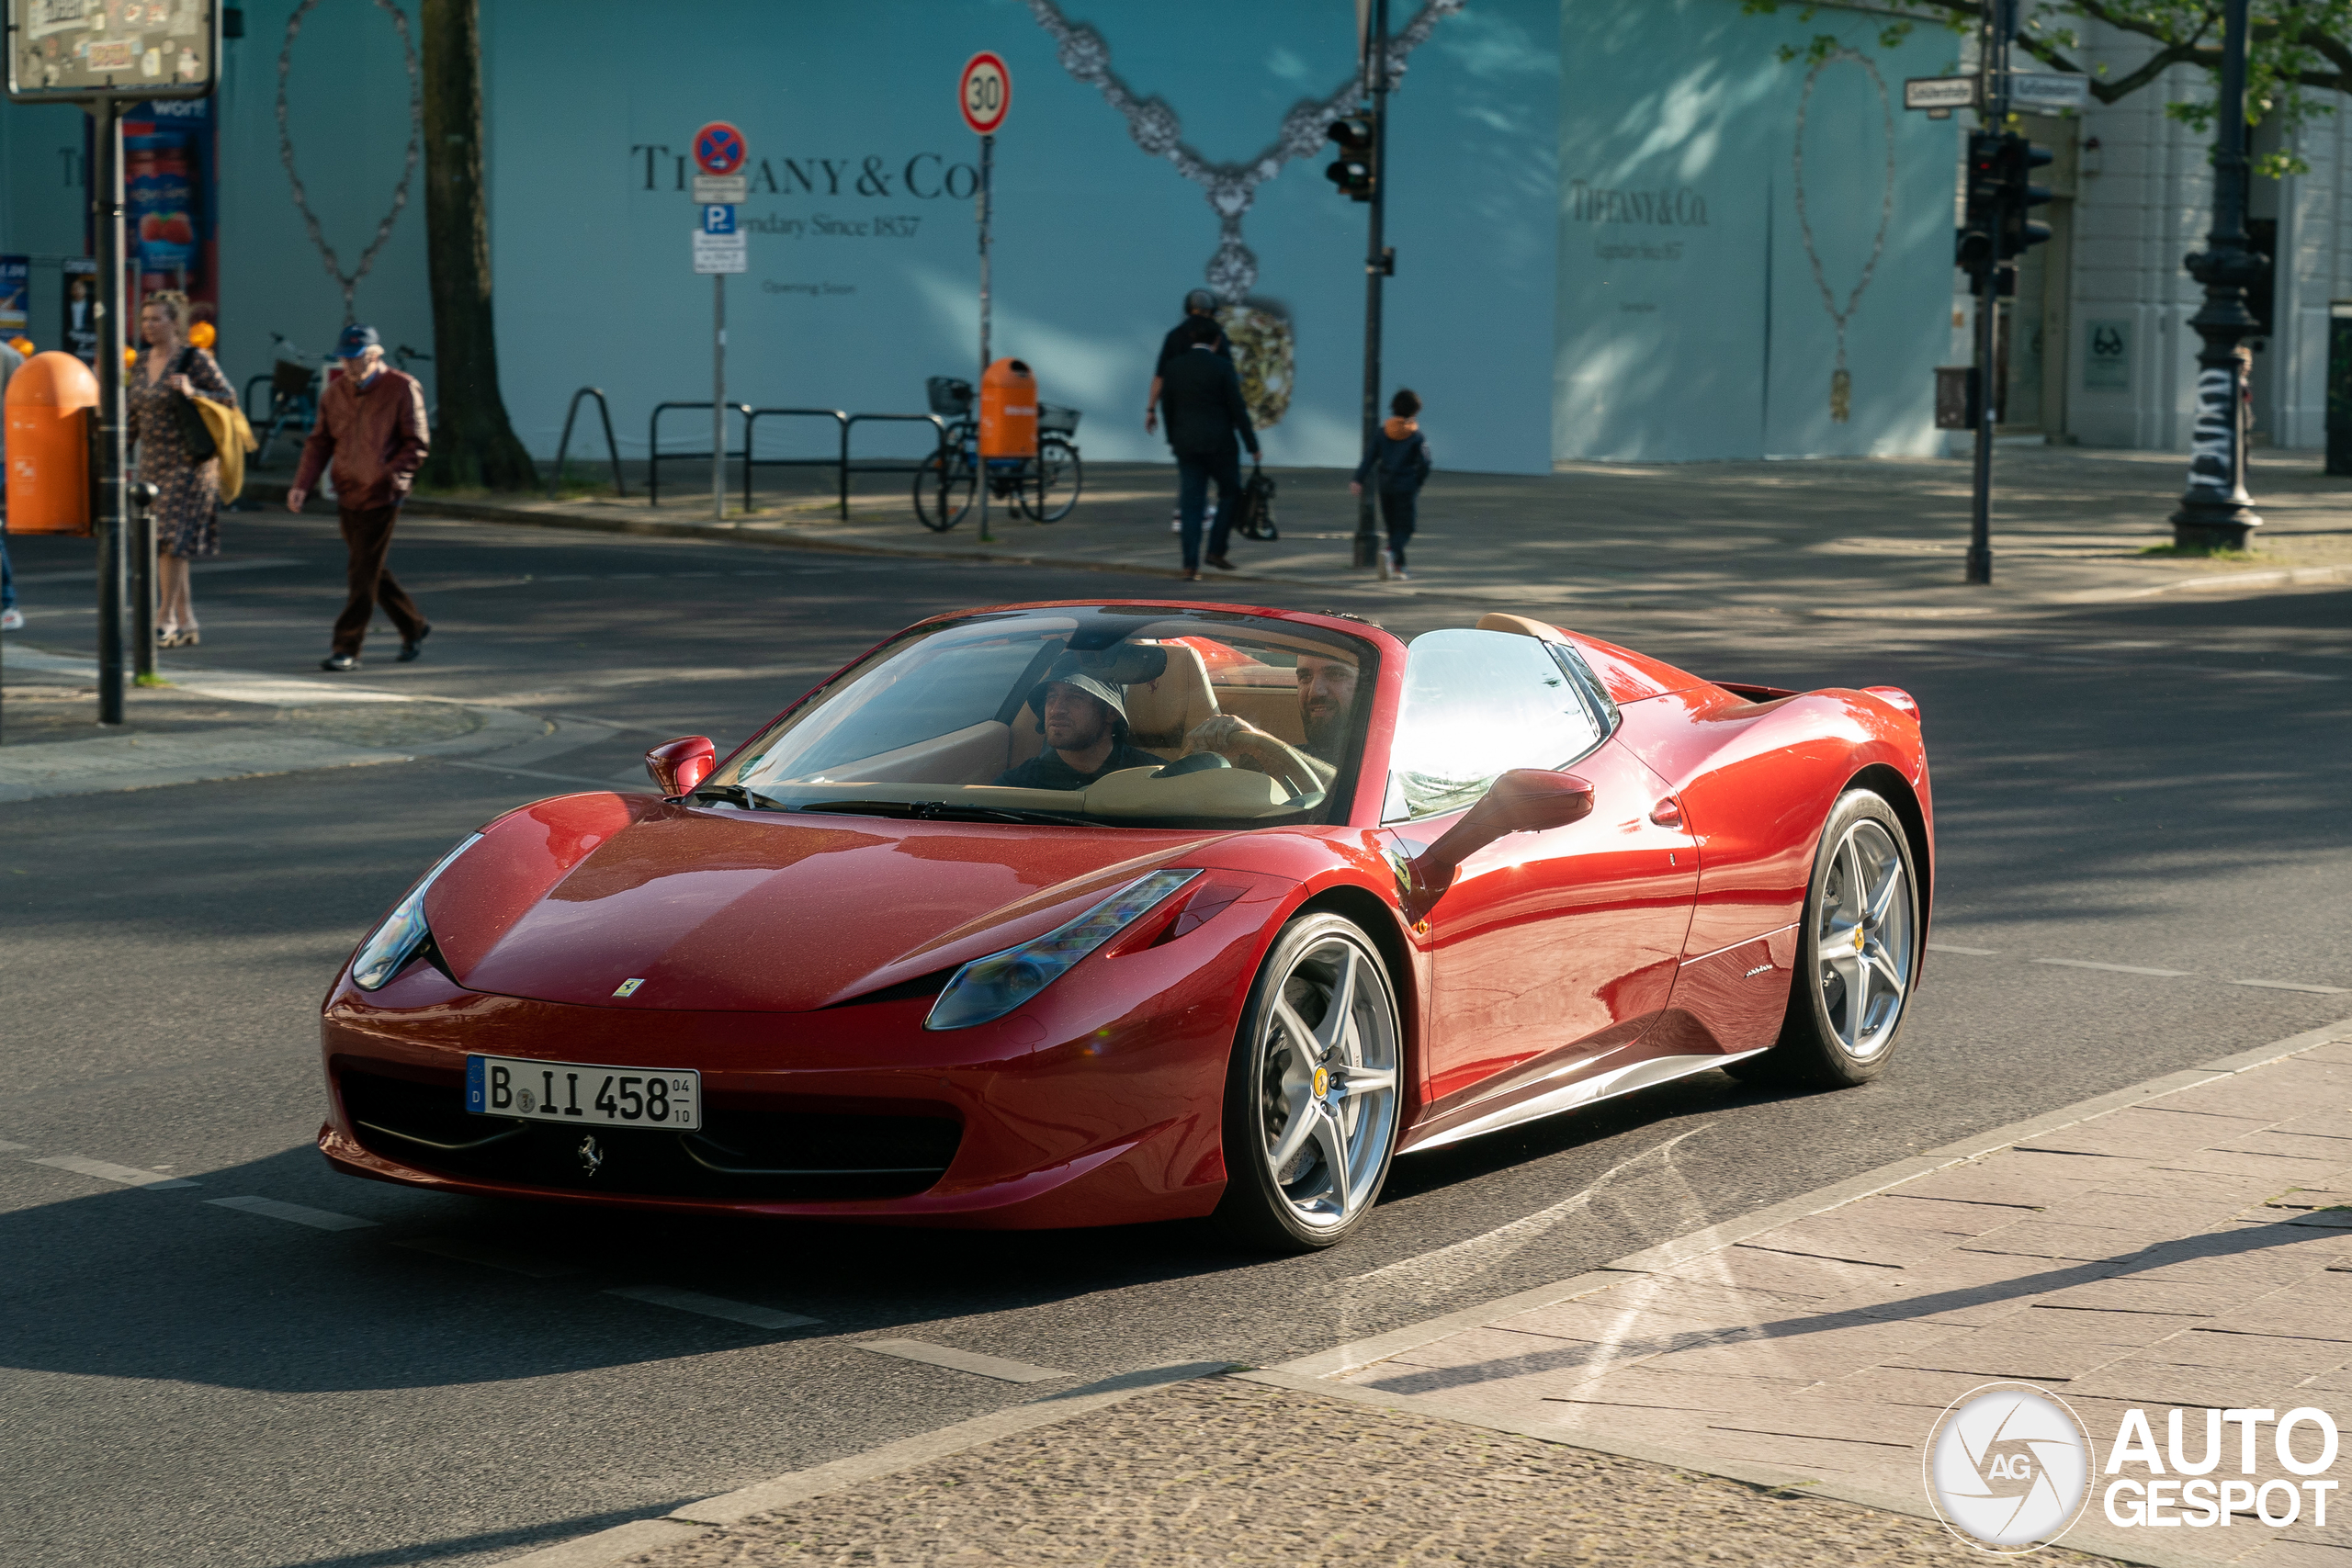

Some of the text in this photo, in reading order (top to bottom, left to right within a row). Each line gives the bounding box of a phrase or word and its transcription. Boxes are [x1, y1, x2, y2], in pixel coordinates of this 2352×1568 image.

[968, 75, 1000, 111] 30
[630, 143, 851, 197] TIANY
[707, 205, 728, 231] P
[472, 1090, 481, 1104] D
[491, 1065, 671, 1122] B II 458
[673, 1078, 691, 1092] 04
[673, 1109, 690, 1123] 10
